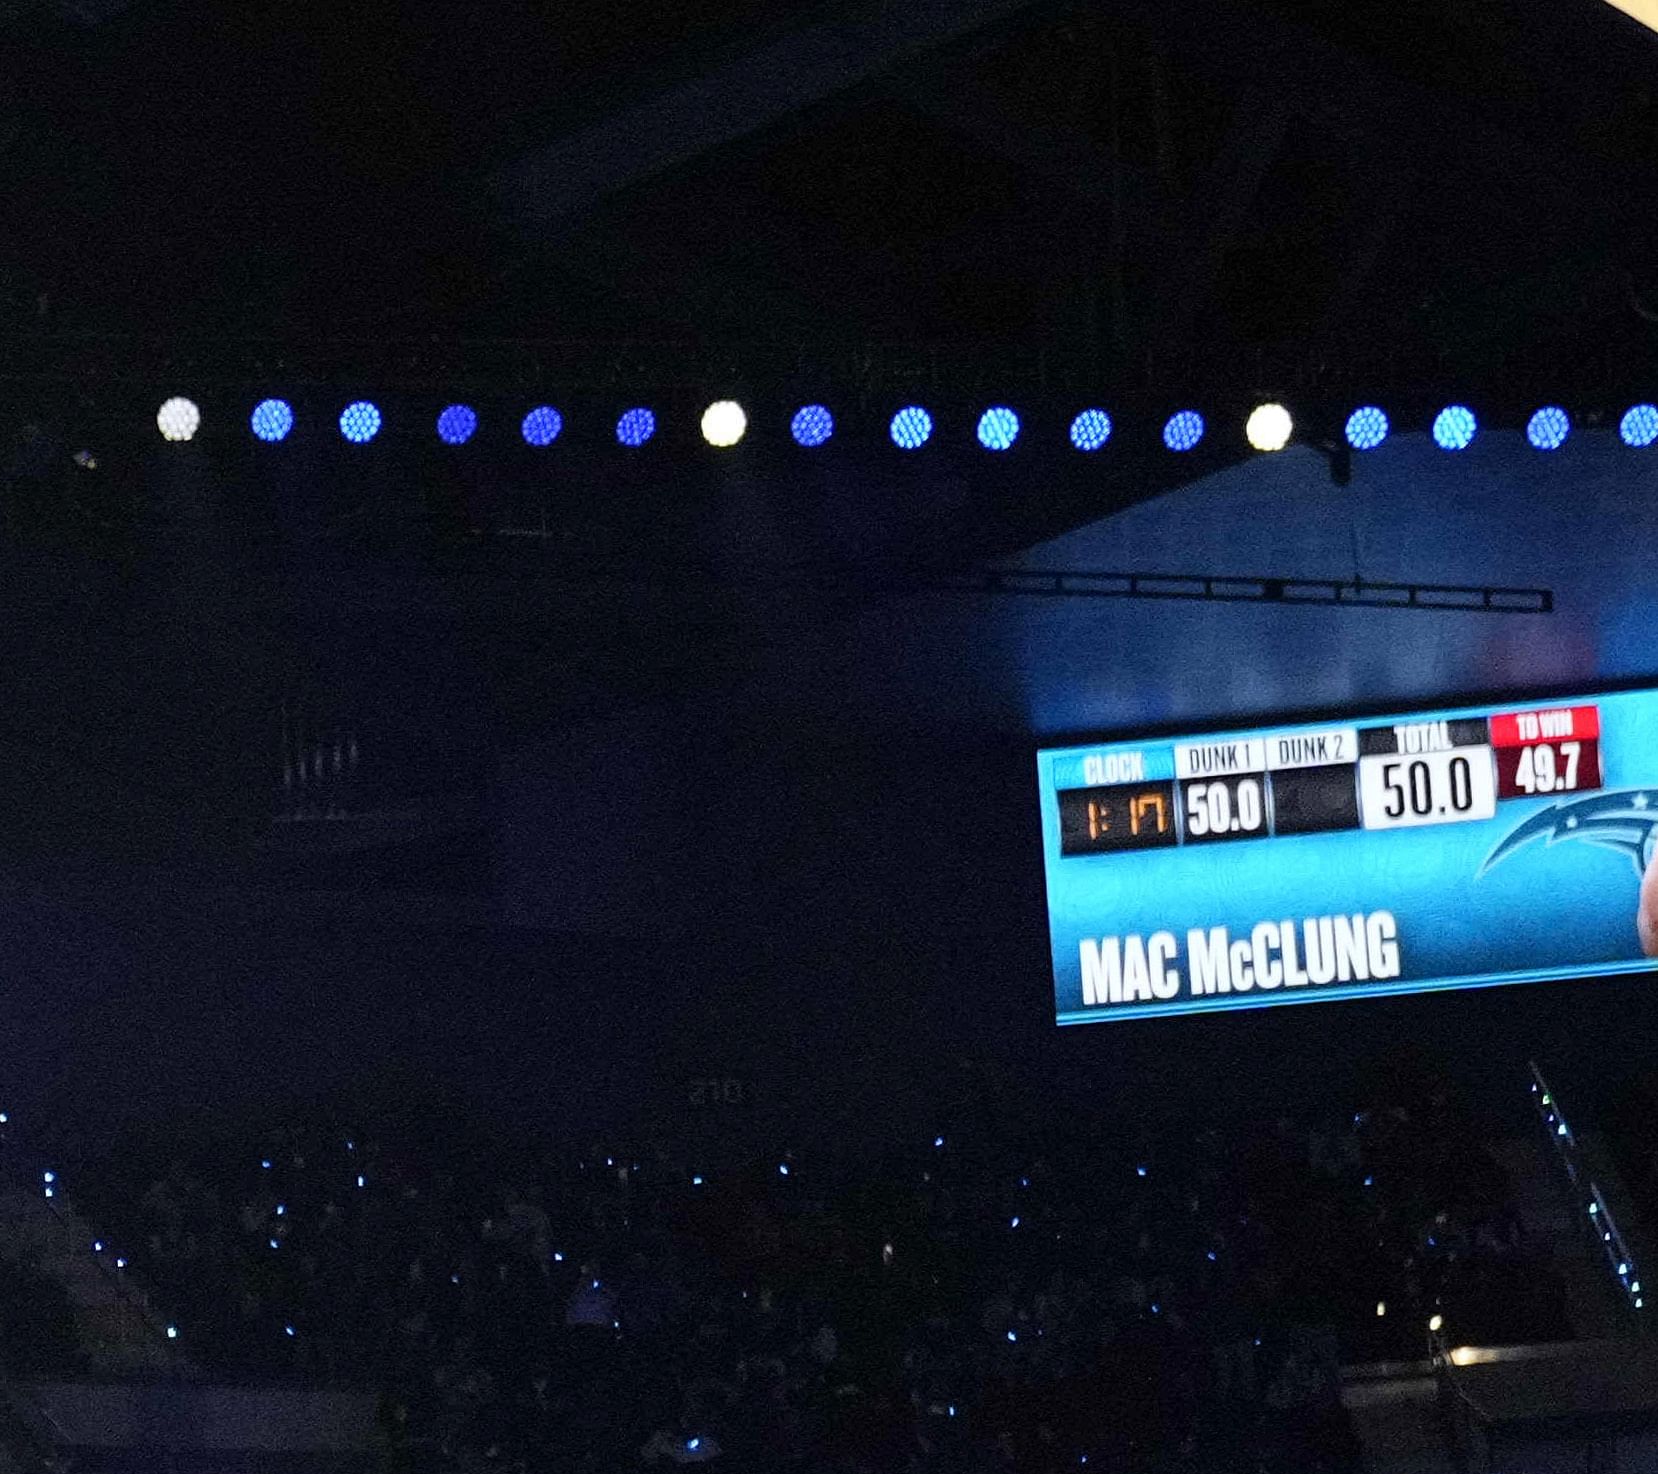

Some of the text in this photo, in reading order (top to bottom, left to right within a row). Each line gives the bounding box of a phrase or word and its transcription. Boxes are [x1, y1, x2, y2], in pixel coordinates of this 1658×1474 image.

[1188, 739, 1252, 774] DUNK 1
[1278, 734, 1345, 767] DUNK 2
[1393, 720, 1453, 755] TOTAL
[1382, 756, 1473, 818] 50.0
[1514, 741, 1580, 795] 49.7
[1186, 778, 1263, 836] 50.0
[1079, 908, 1401, 1007] MAC McCLUNG
